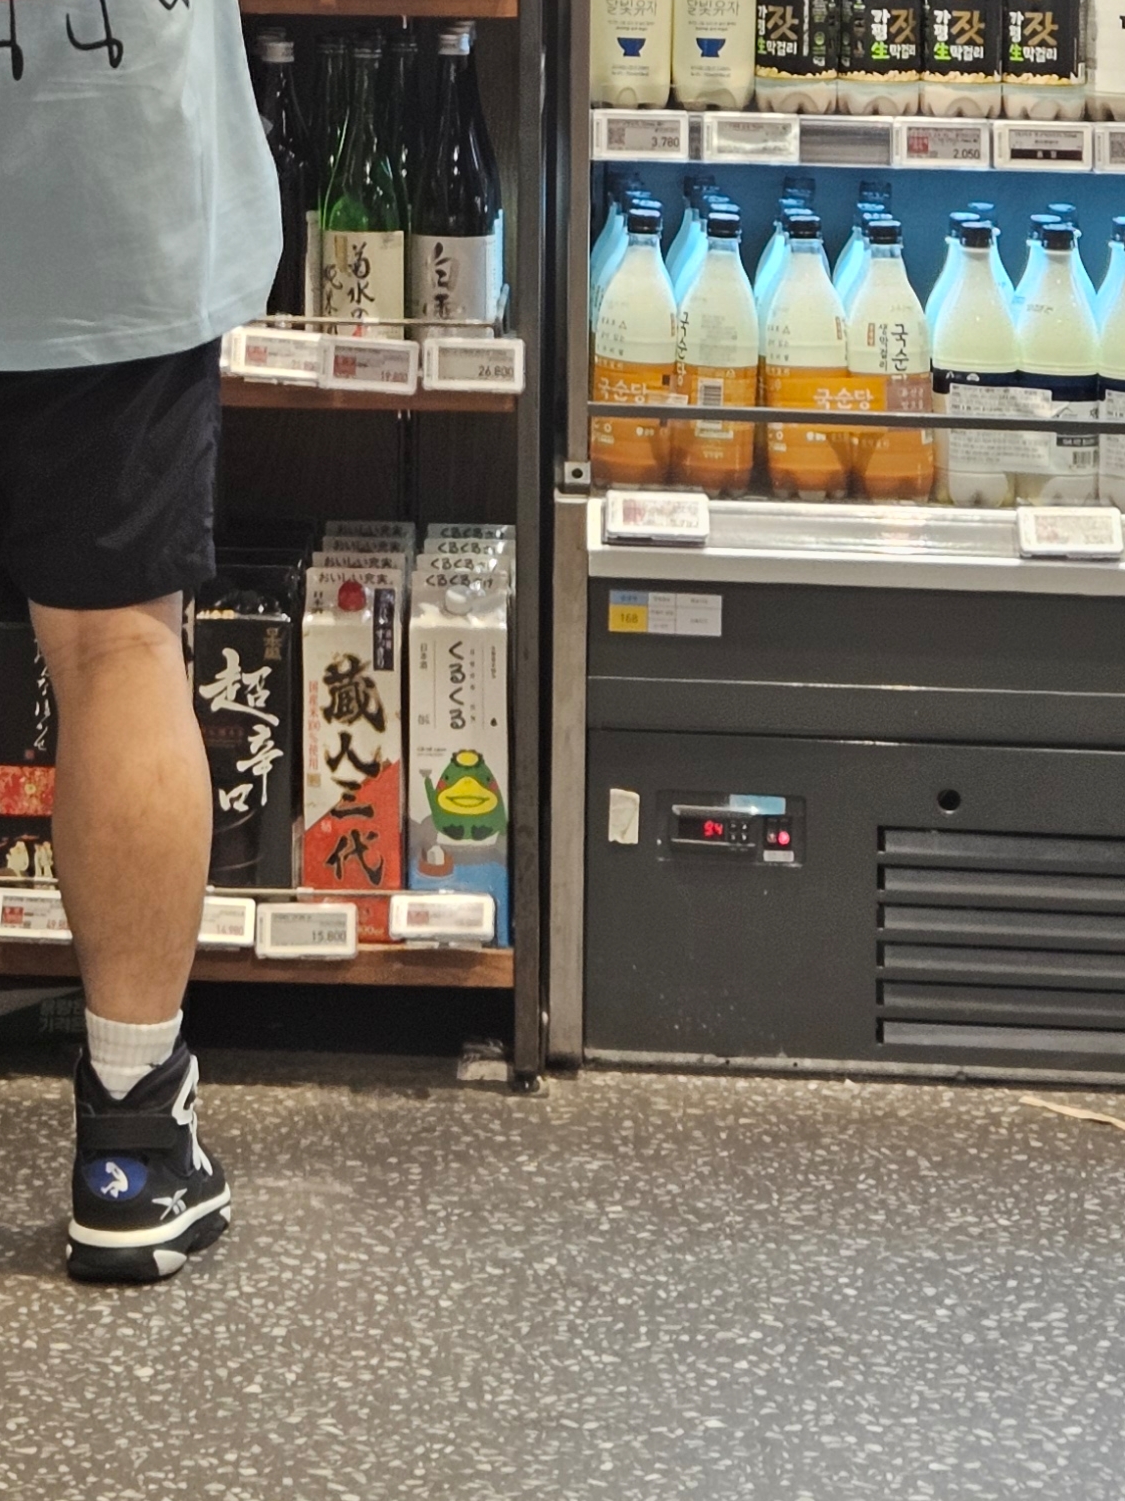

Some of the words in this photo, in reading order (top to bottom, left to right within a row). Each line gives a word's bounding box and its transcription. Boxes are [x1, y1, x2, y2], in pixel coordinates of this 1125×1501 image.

[871, 9, 891, 42] 가평
[890, 8, 915, 43] 잣
[933, 9, 952, 42] 가평
[951, 9, 986, 45] 잣
[1008, 11, 1024, 43] 가평
[1023, 12, 1059, 46] 잣
[652, 137, 680, 148] 3.780
[953, 149, 981, 159] 2.050
[598, 377, 649, 404] 국순당
[814, 388, 874, 410] 국순당
[318, 572, 395, 586] おいしい充実。
[448, 641, 467, 731] くるくる
[198, 648, 285, 816] 超辛口
[320, 653, 387, 887] 蔵人三代
[311, 931, 347, 943] 15.800
